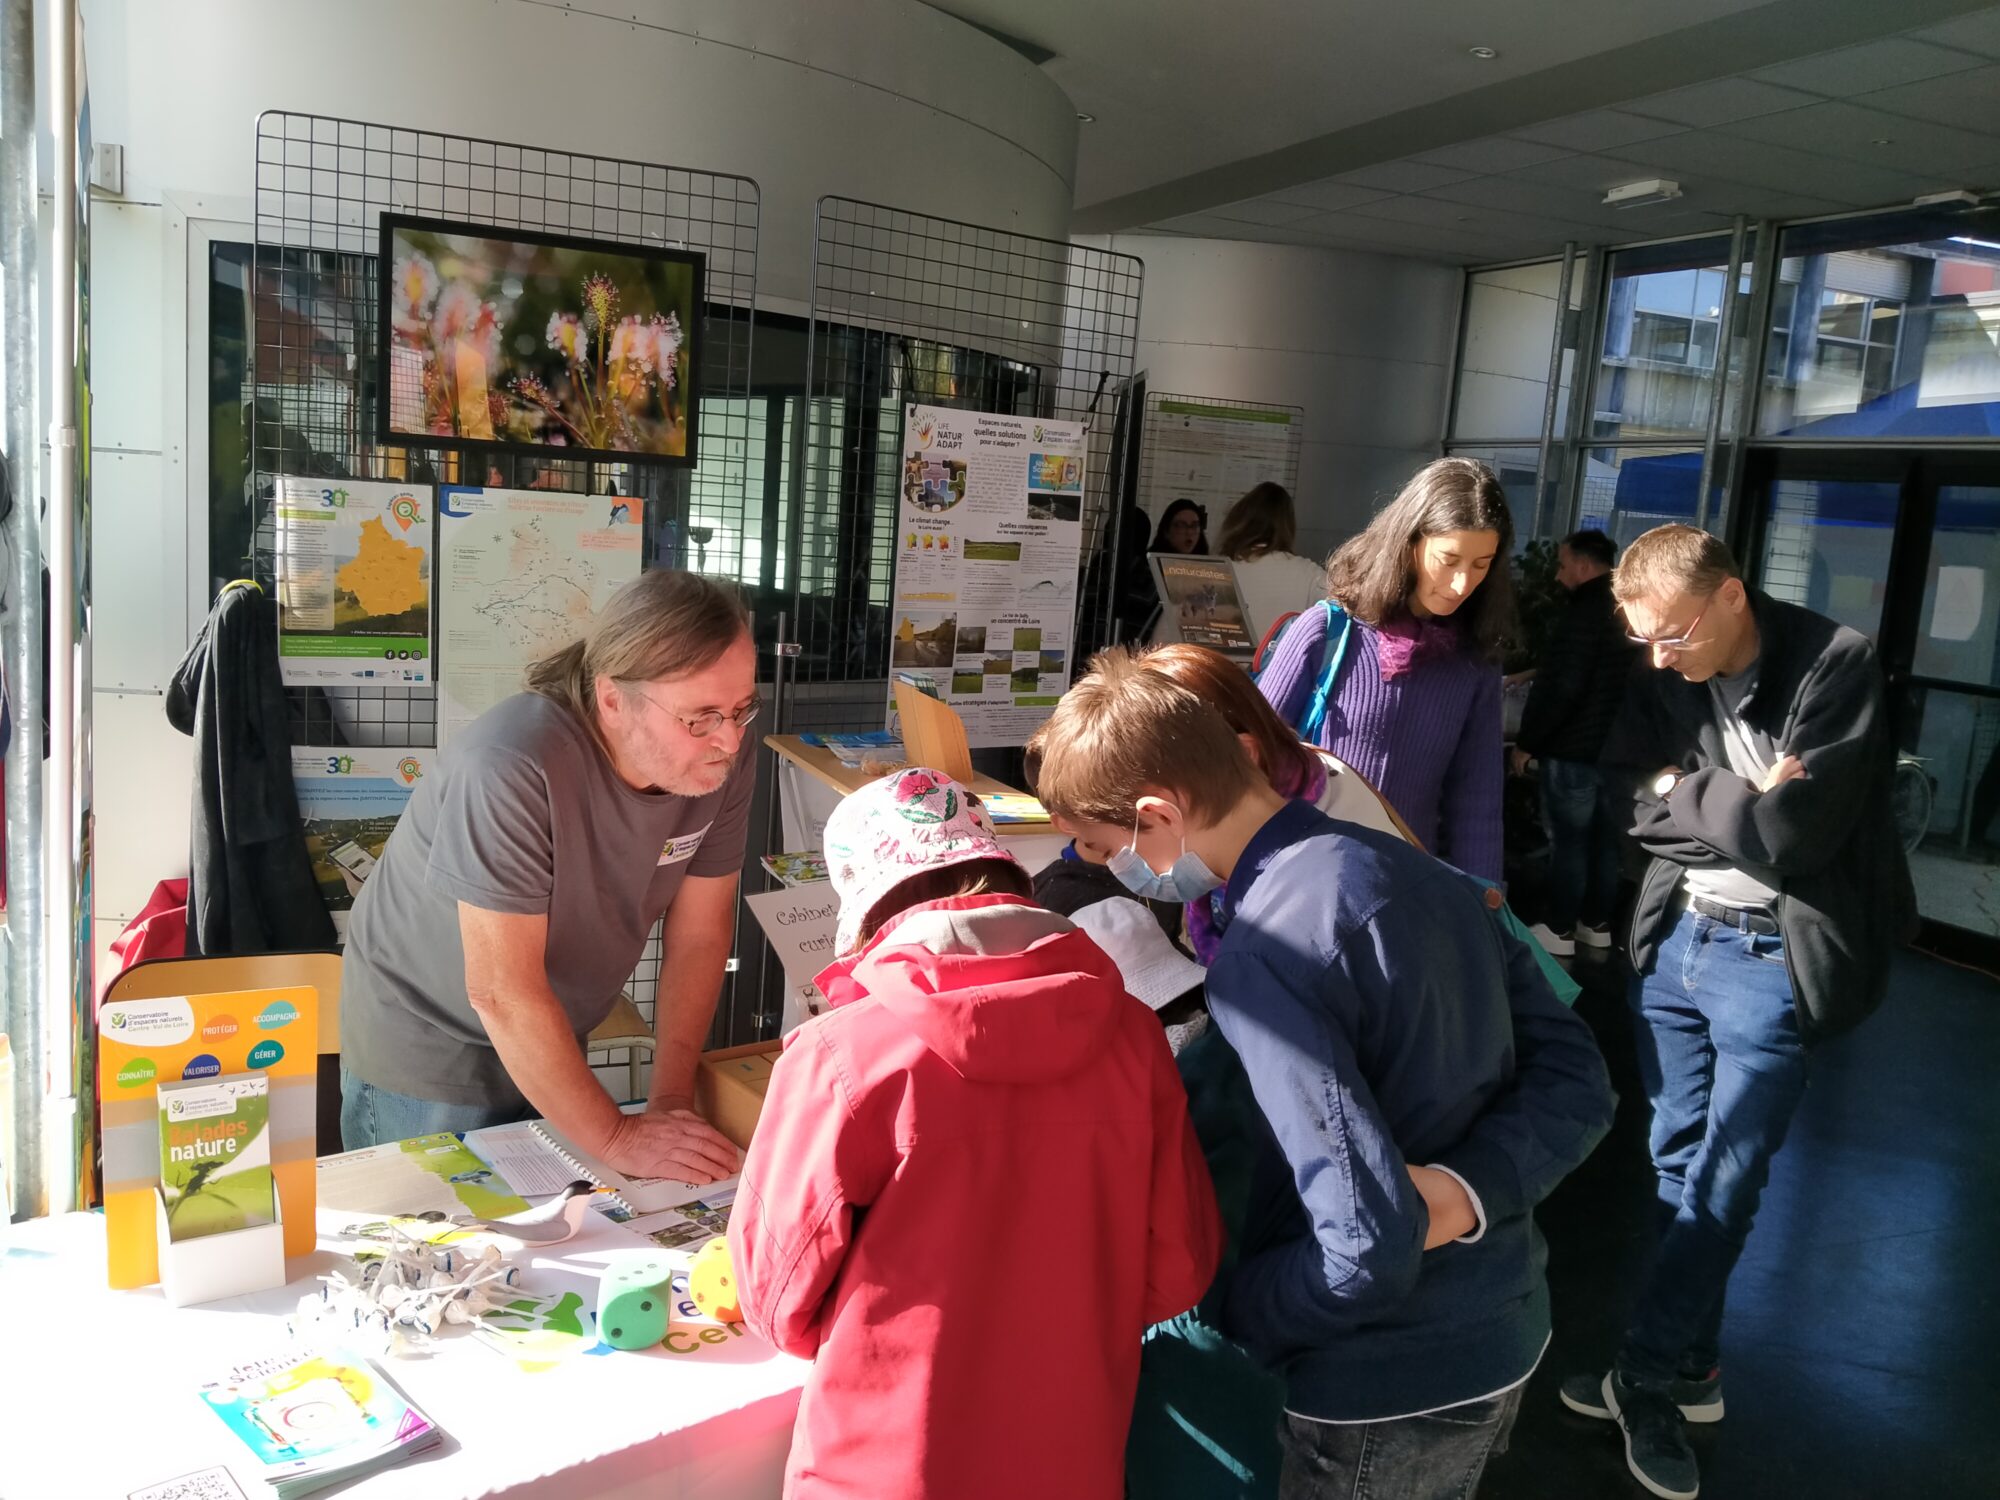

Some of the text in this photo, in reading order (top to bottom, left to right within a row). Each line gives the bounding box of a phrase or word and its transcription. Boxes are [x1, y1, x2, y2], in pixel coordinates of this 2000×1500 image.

[938, 422, 950, 431] LIFE
[973, 428, 1027, 440] quelles solutions
[936, 439, 963, 450] ADAPT
[979, 439, 992, 447] pour
[1167, 566, 1225, 581] naturalistes
[776, 903, 838, 926] Cabinet
[127, 1011, 169, 1021] Conservatoire
[127, 1015, 184, 1028] d'espaces naturels
[252, 1010, 302, 1025] ACCOMPAGNER
[202, 1023, 239, 1037] PROTÉGER
[254, 1047, 277, 1060] GÉRER
[116, 1067, 156, 1082] CONNAÎTRE
[183, 1063, 220, 1078] VALORISER
[169, 1119, 249, 1145] Balades
[170, 1136, 237, 1163] nature
